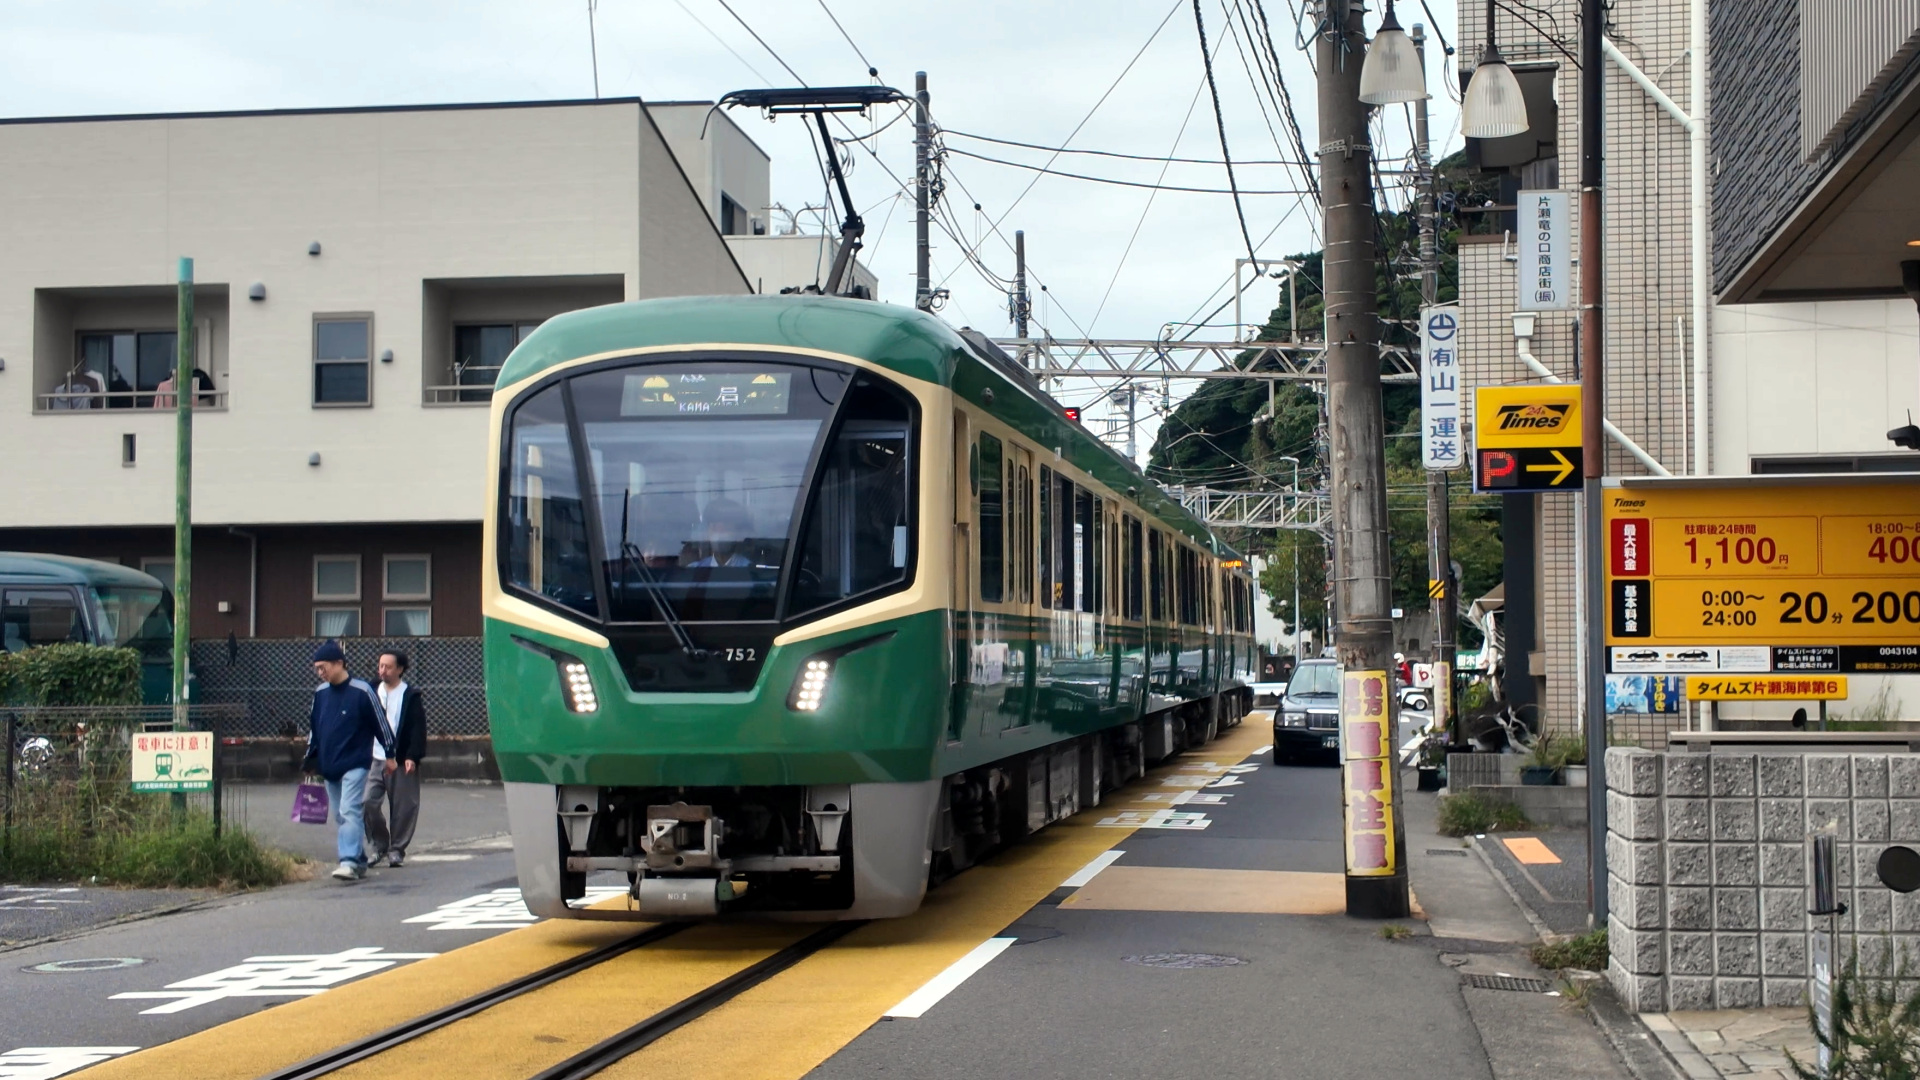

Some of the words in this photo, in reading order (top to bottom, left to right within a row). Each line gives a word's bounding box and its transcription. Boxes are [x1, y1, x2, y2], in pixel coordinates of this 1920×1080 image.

[1498, 410, 1562, 430] Times
[1482, 451, 1516, 487] P
[1613, 497, 1647, 508] Times
[1684, 523, 1757, 535] 駐車後24時間
[1624, 524, 1637, 571] 最大料金
[1624, 585, 1638, 632] 基本料金
[1702, 610, 1757, 626] 24:00
[725, 648, 757, 662] 752
[1697, 681, 1838, 695] タイムズ片瀬海岸第6
